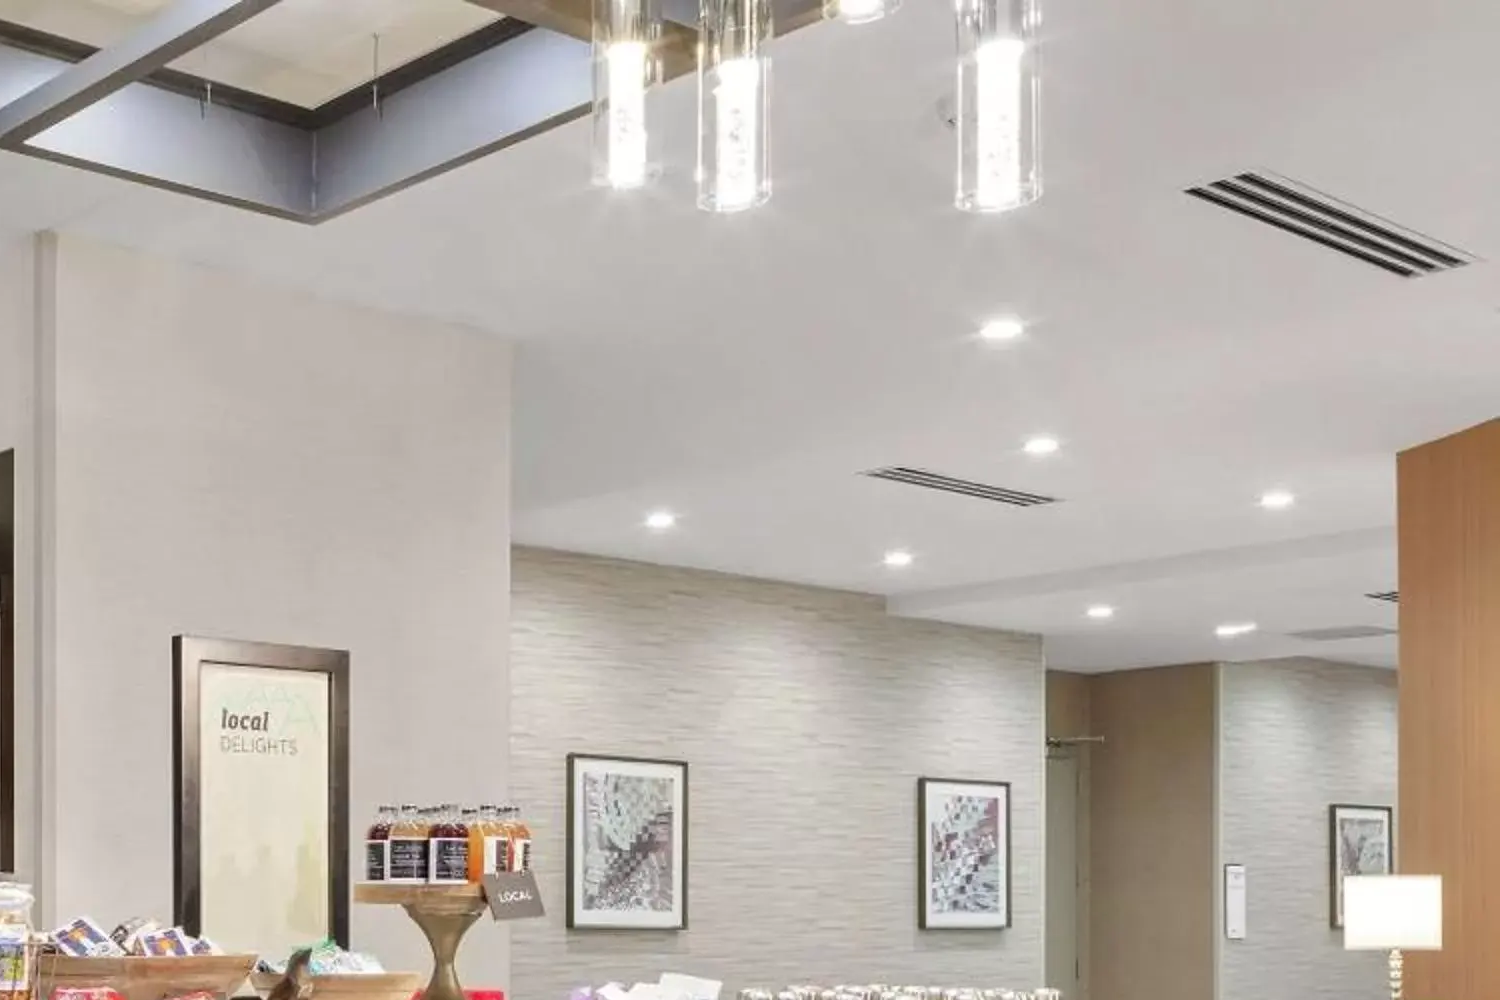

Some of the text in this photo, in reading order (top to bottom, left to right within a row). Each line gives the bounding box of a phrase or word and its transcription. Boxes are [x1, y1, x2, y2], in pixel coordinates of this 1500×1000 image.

[221, 708, 269, 732] local
[219, 735, 299, 756] DELIGHTS
[497, 889, 533, 903] LOCAL
